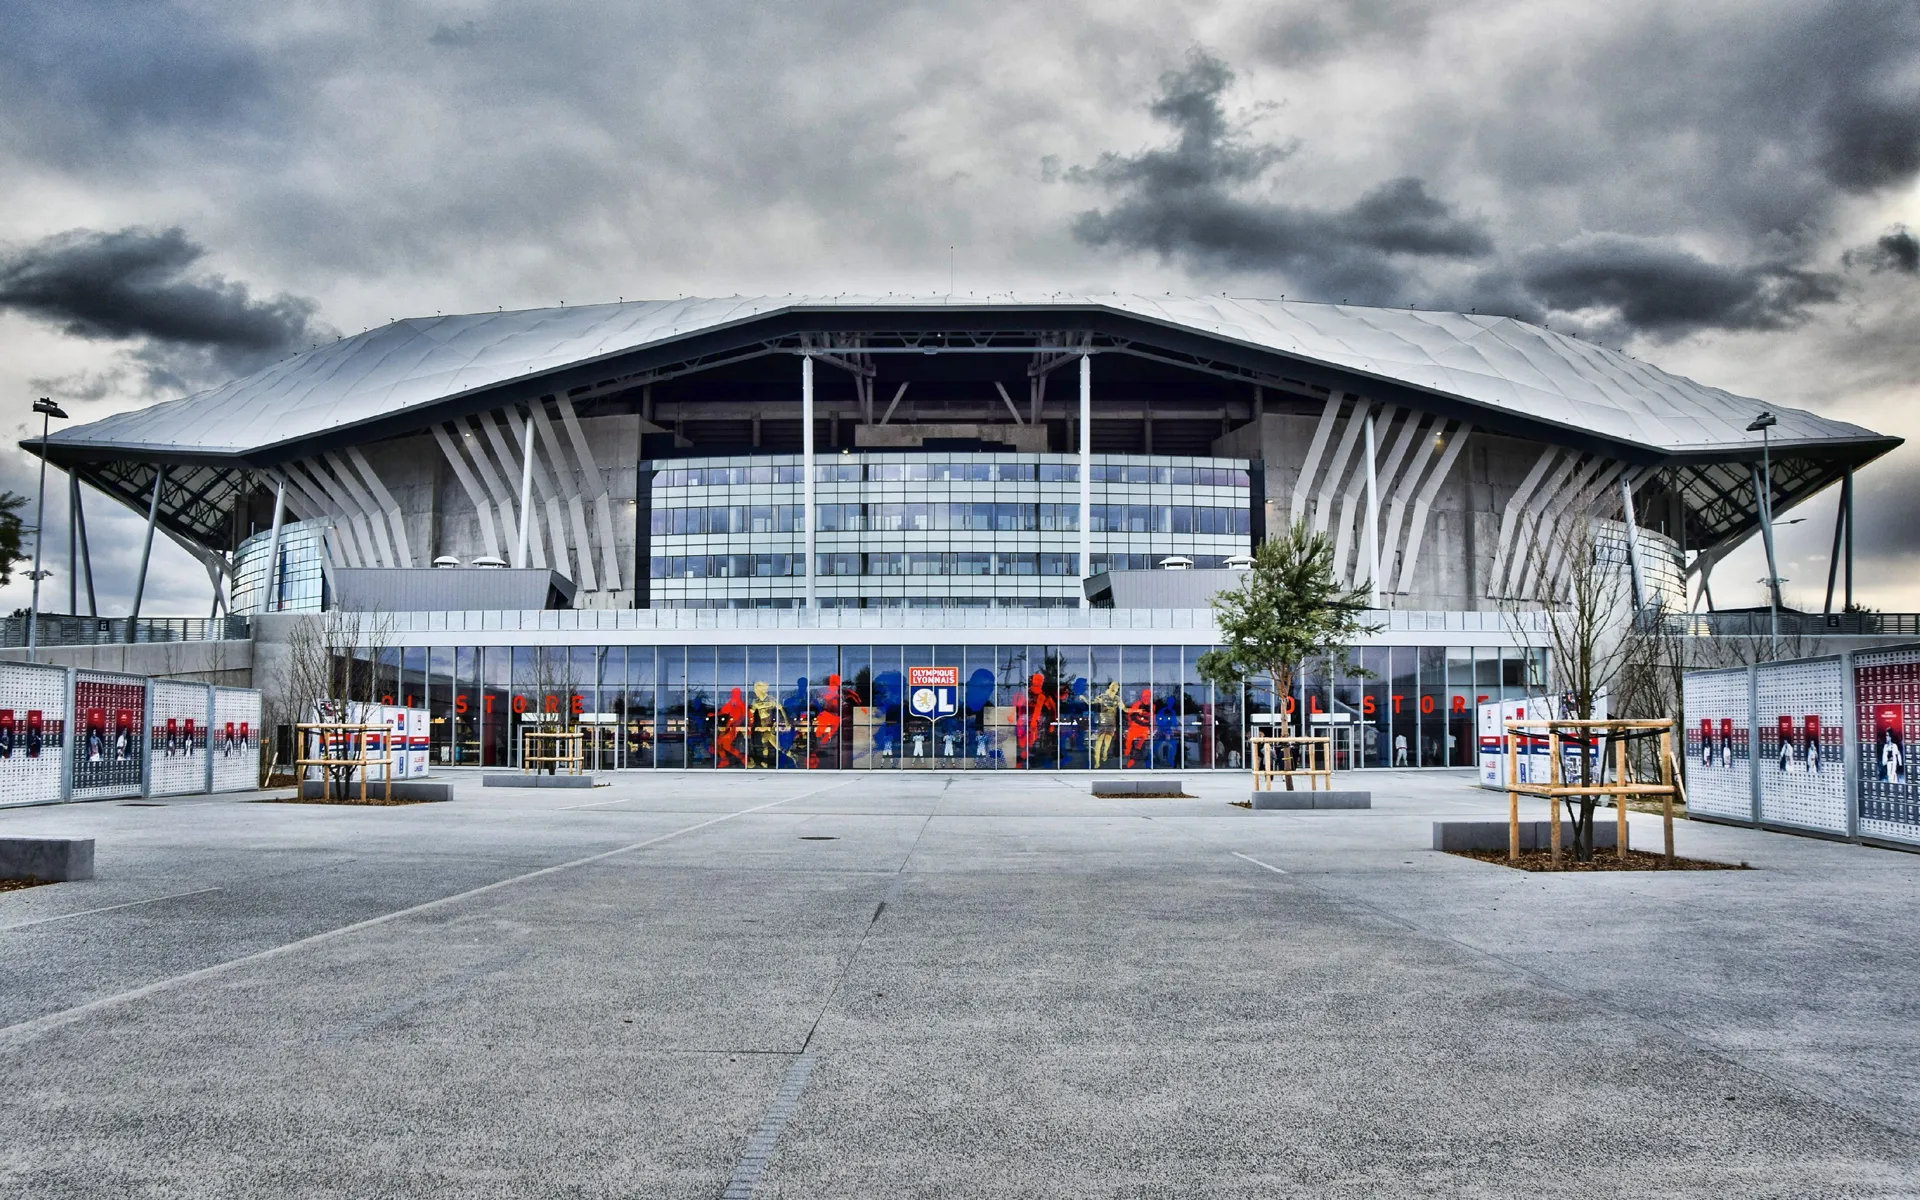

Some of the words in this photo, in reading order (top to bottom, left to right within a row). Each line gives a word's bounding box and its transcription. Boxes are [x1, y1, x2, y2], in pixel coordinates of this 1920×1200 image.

[912, 669, 955, 677] OLYMPIQUE
[912, 676, 955, 684] LYONNAIS
[456, 695, 585, 714] STORE
